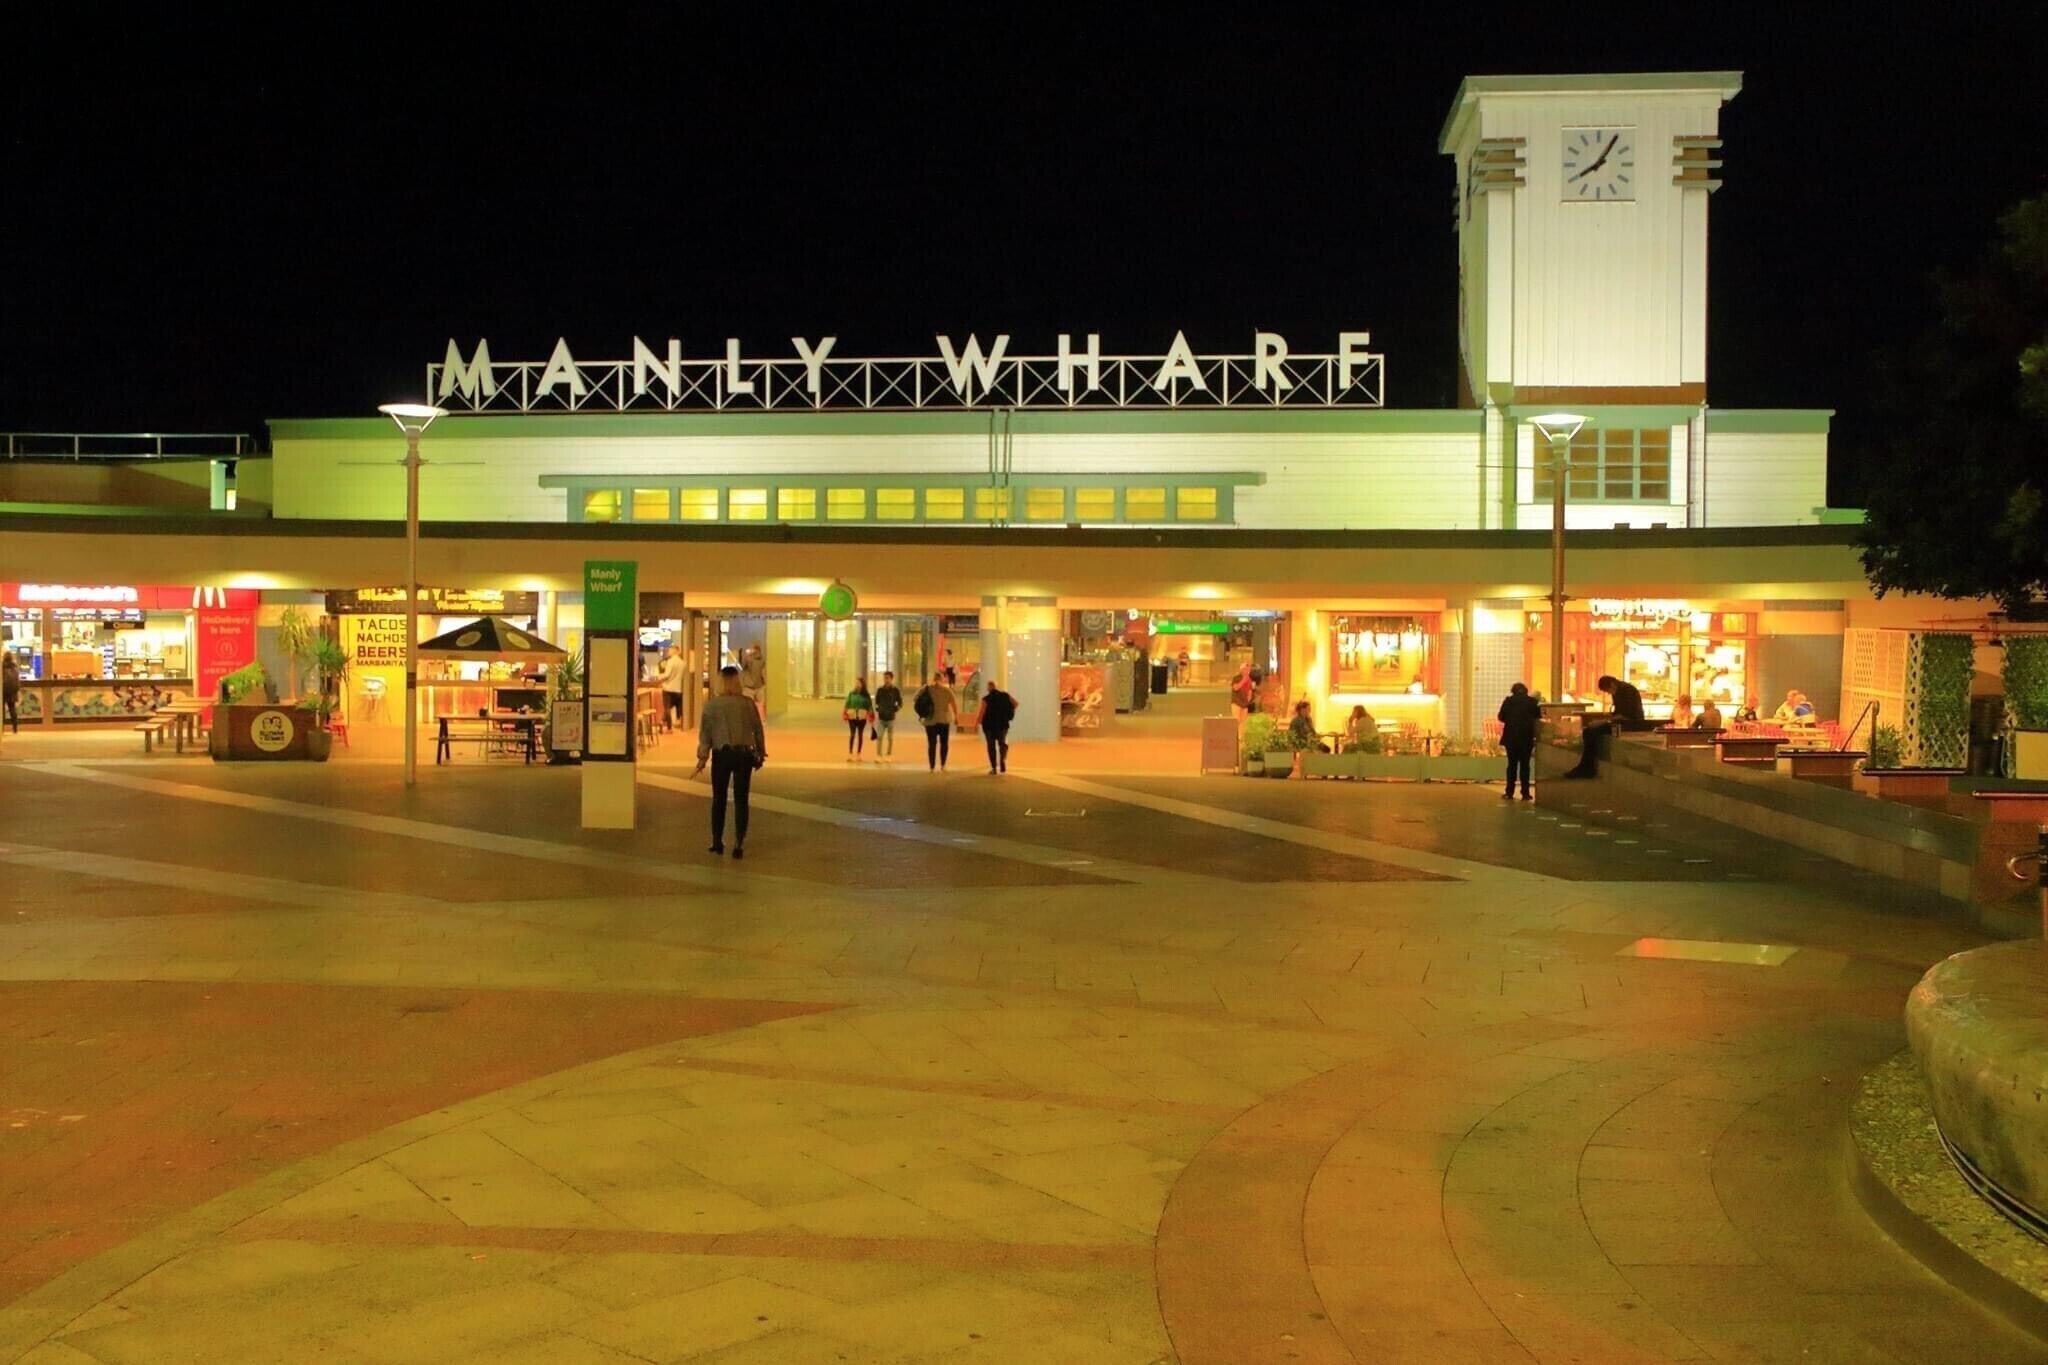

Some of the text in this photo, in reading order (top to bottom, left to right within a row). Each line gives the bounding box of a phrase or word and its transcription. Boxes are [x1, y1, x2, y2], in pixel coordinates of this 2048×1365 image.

[439, 329, 1370, 398] MANLY WHARF
[591, 569, 621, 581] Manly
[591, 582, 622, 592] Wharf
[357, 618, 408, 630] TACOS
[357, 633, 407, 643] NACHOS
[357, 645, 407, 658] BEERS
